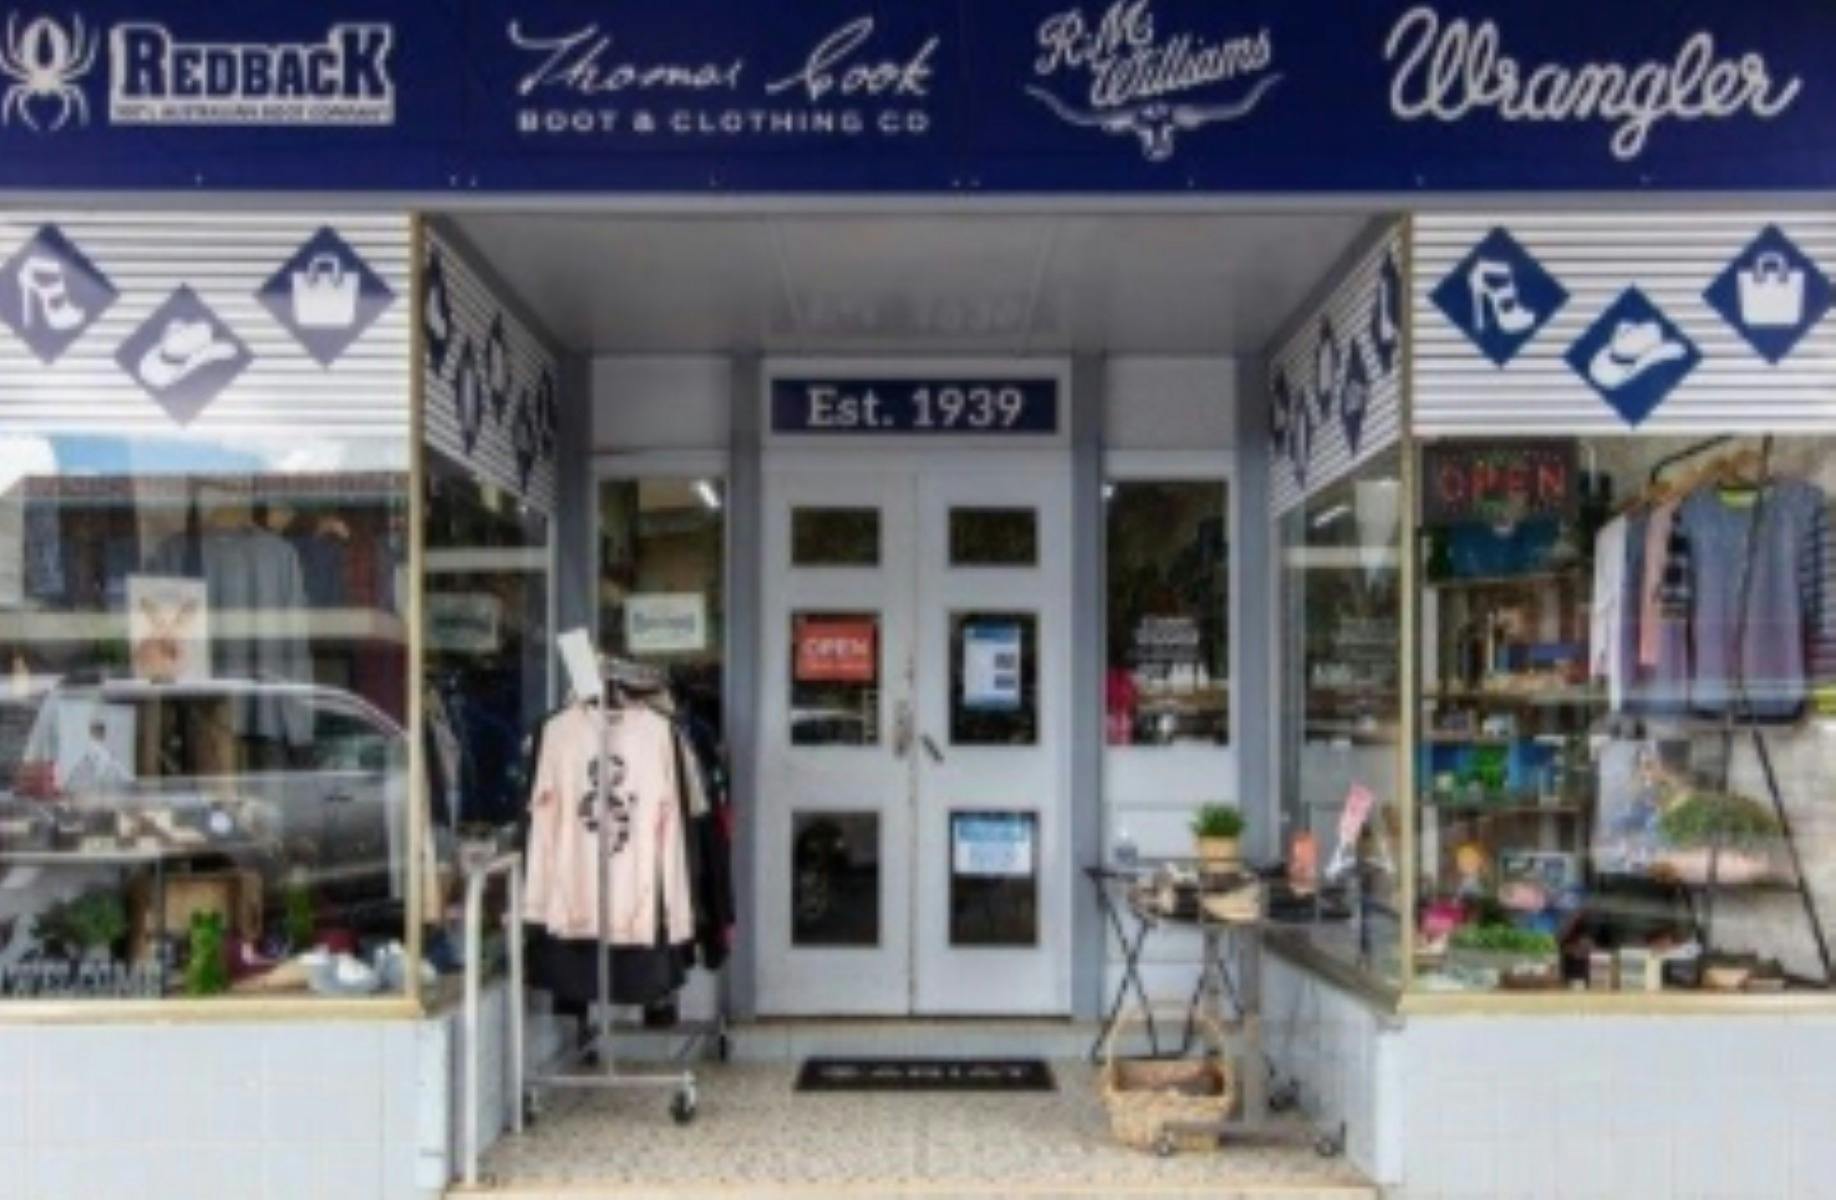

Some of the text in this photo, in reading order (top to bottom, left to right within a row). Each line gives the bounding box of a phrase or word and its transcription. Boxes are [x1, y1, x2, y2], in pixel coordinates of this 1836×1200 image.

[109, 23, 394, 99] REDBACK
[506, 15, 941, 101] Thomas Cook
[1090, 26, 1272, 106] Williams
[1384, 5, 1801, 159] Wrangler
[517, 109, 931, 132] BOOT & CLOTHING CO
[806, 384, 1025, 428] Est. 1939
[802, 637, 870, 655] OPEN
